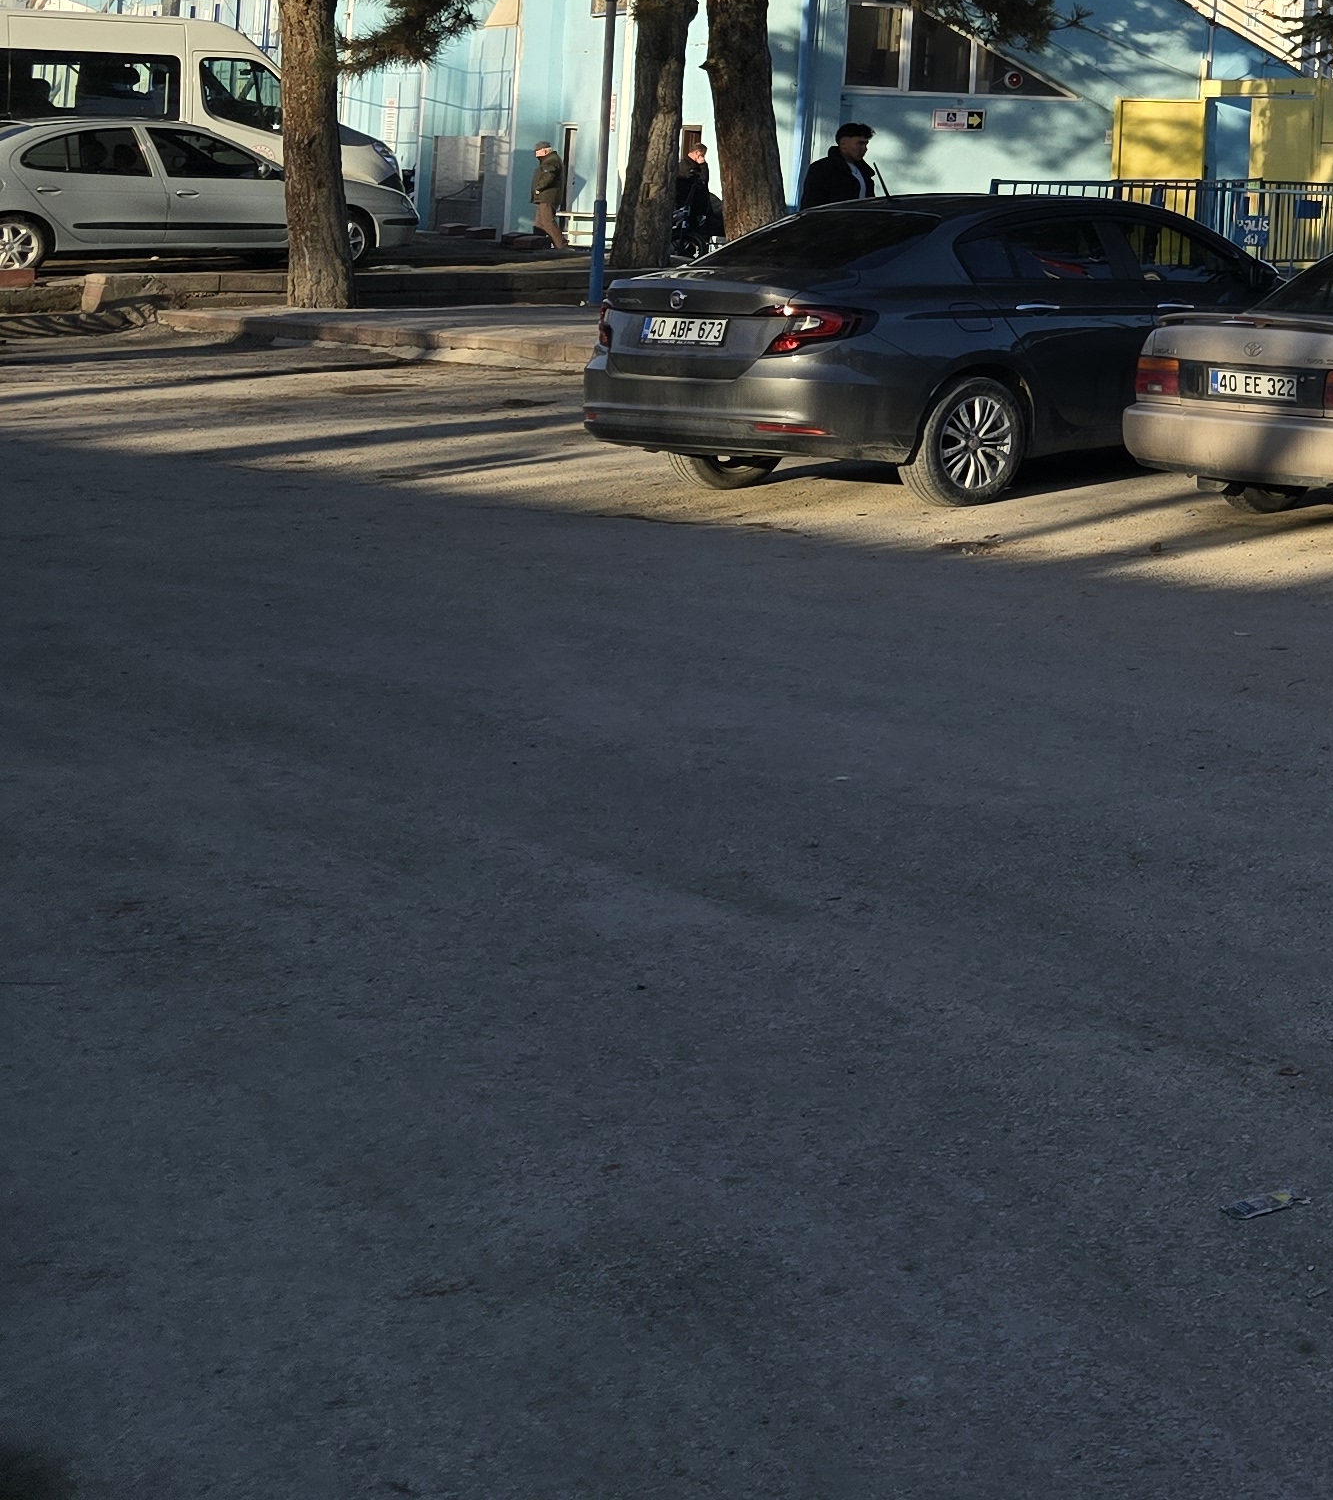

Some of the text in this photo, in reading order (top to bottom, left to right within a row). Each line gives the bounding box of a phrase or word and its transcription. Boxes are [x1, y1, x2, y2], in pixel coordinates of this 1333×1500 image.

[1236, 217, 1270, 233] POLİS
[649, 319, 723, 340] 40 ABF 673
[1219, 374, 1238, 393] 40
[1244, 375, 1262, 395] EE
[1267, 377, 1296, 398] 322
